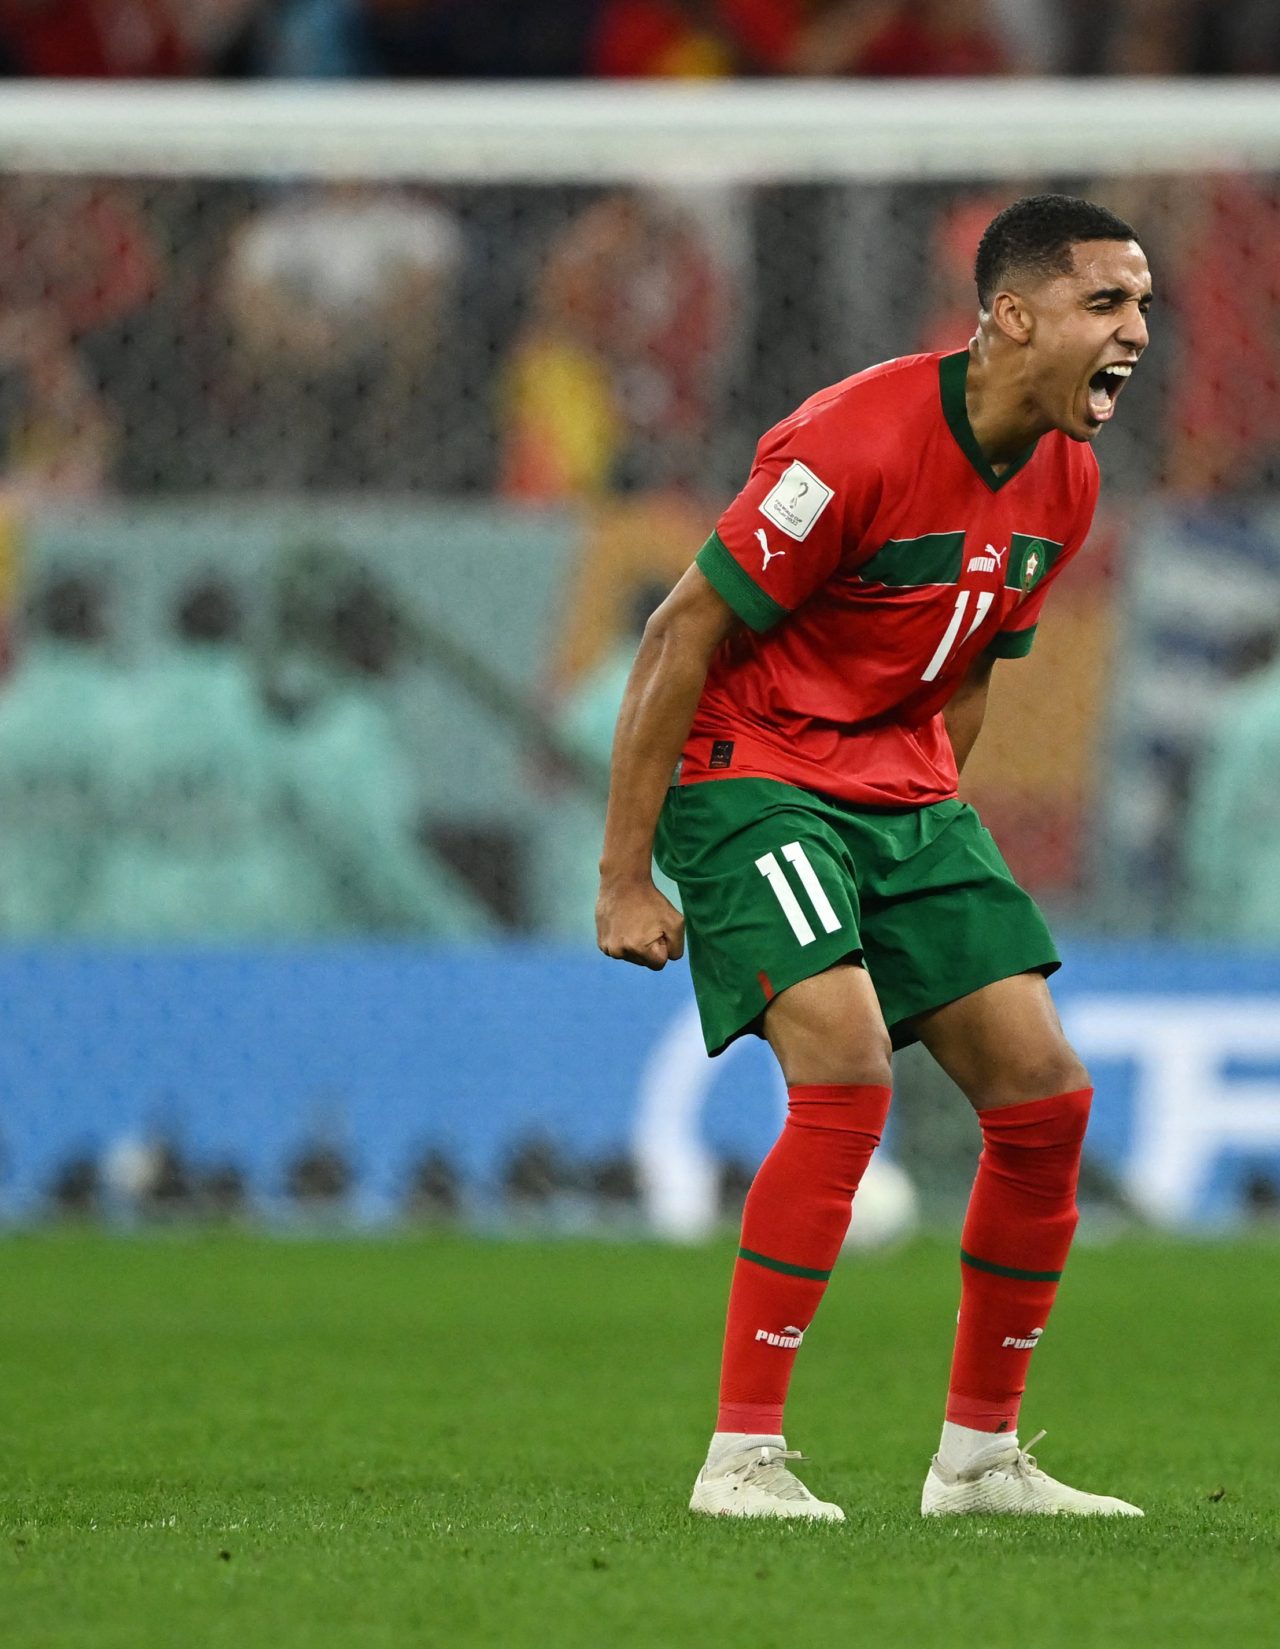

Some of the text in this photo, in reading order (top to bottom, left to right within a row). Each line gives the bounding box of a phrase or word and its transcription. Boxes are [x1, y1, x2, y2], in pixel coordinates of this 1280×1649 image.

[920, 590, 995, 682] 11
[754, 841, 842, 947] 11
[1002, 1336, 1039, 1349] PUM
